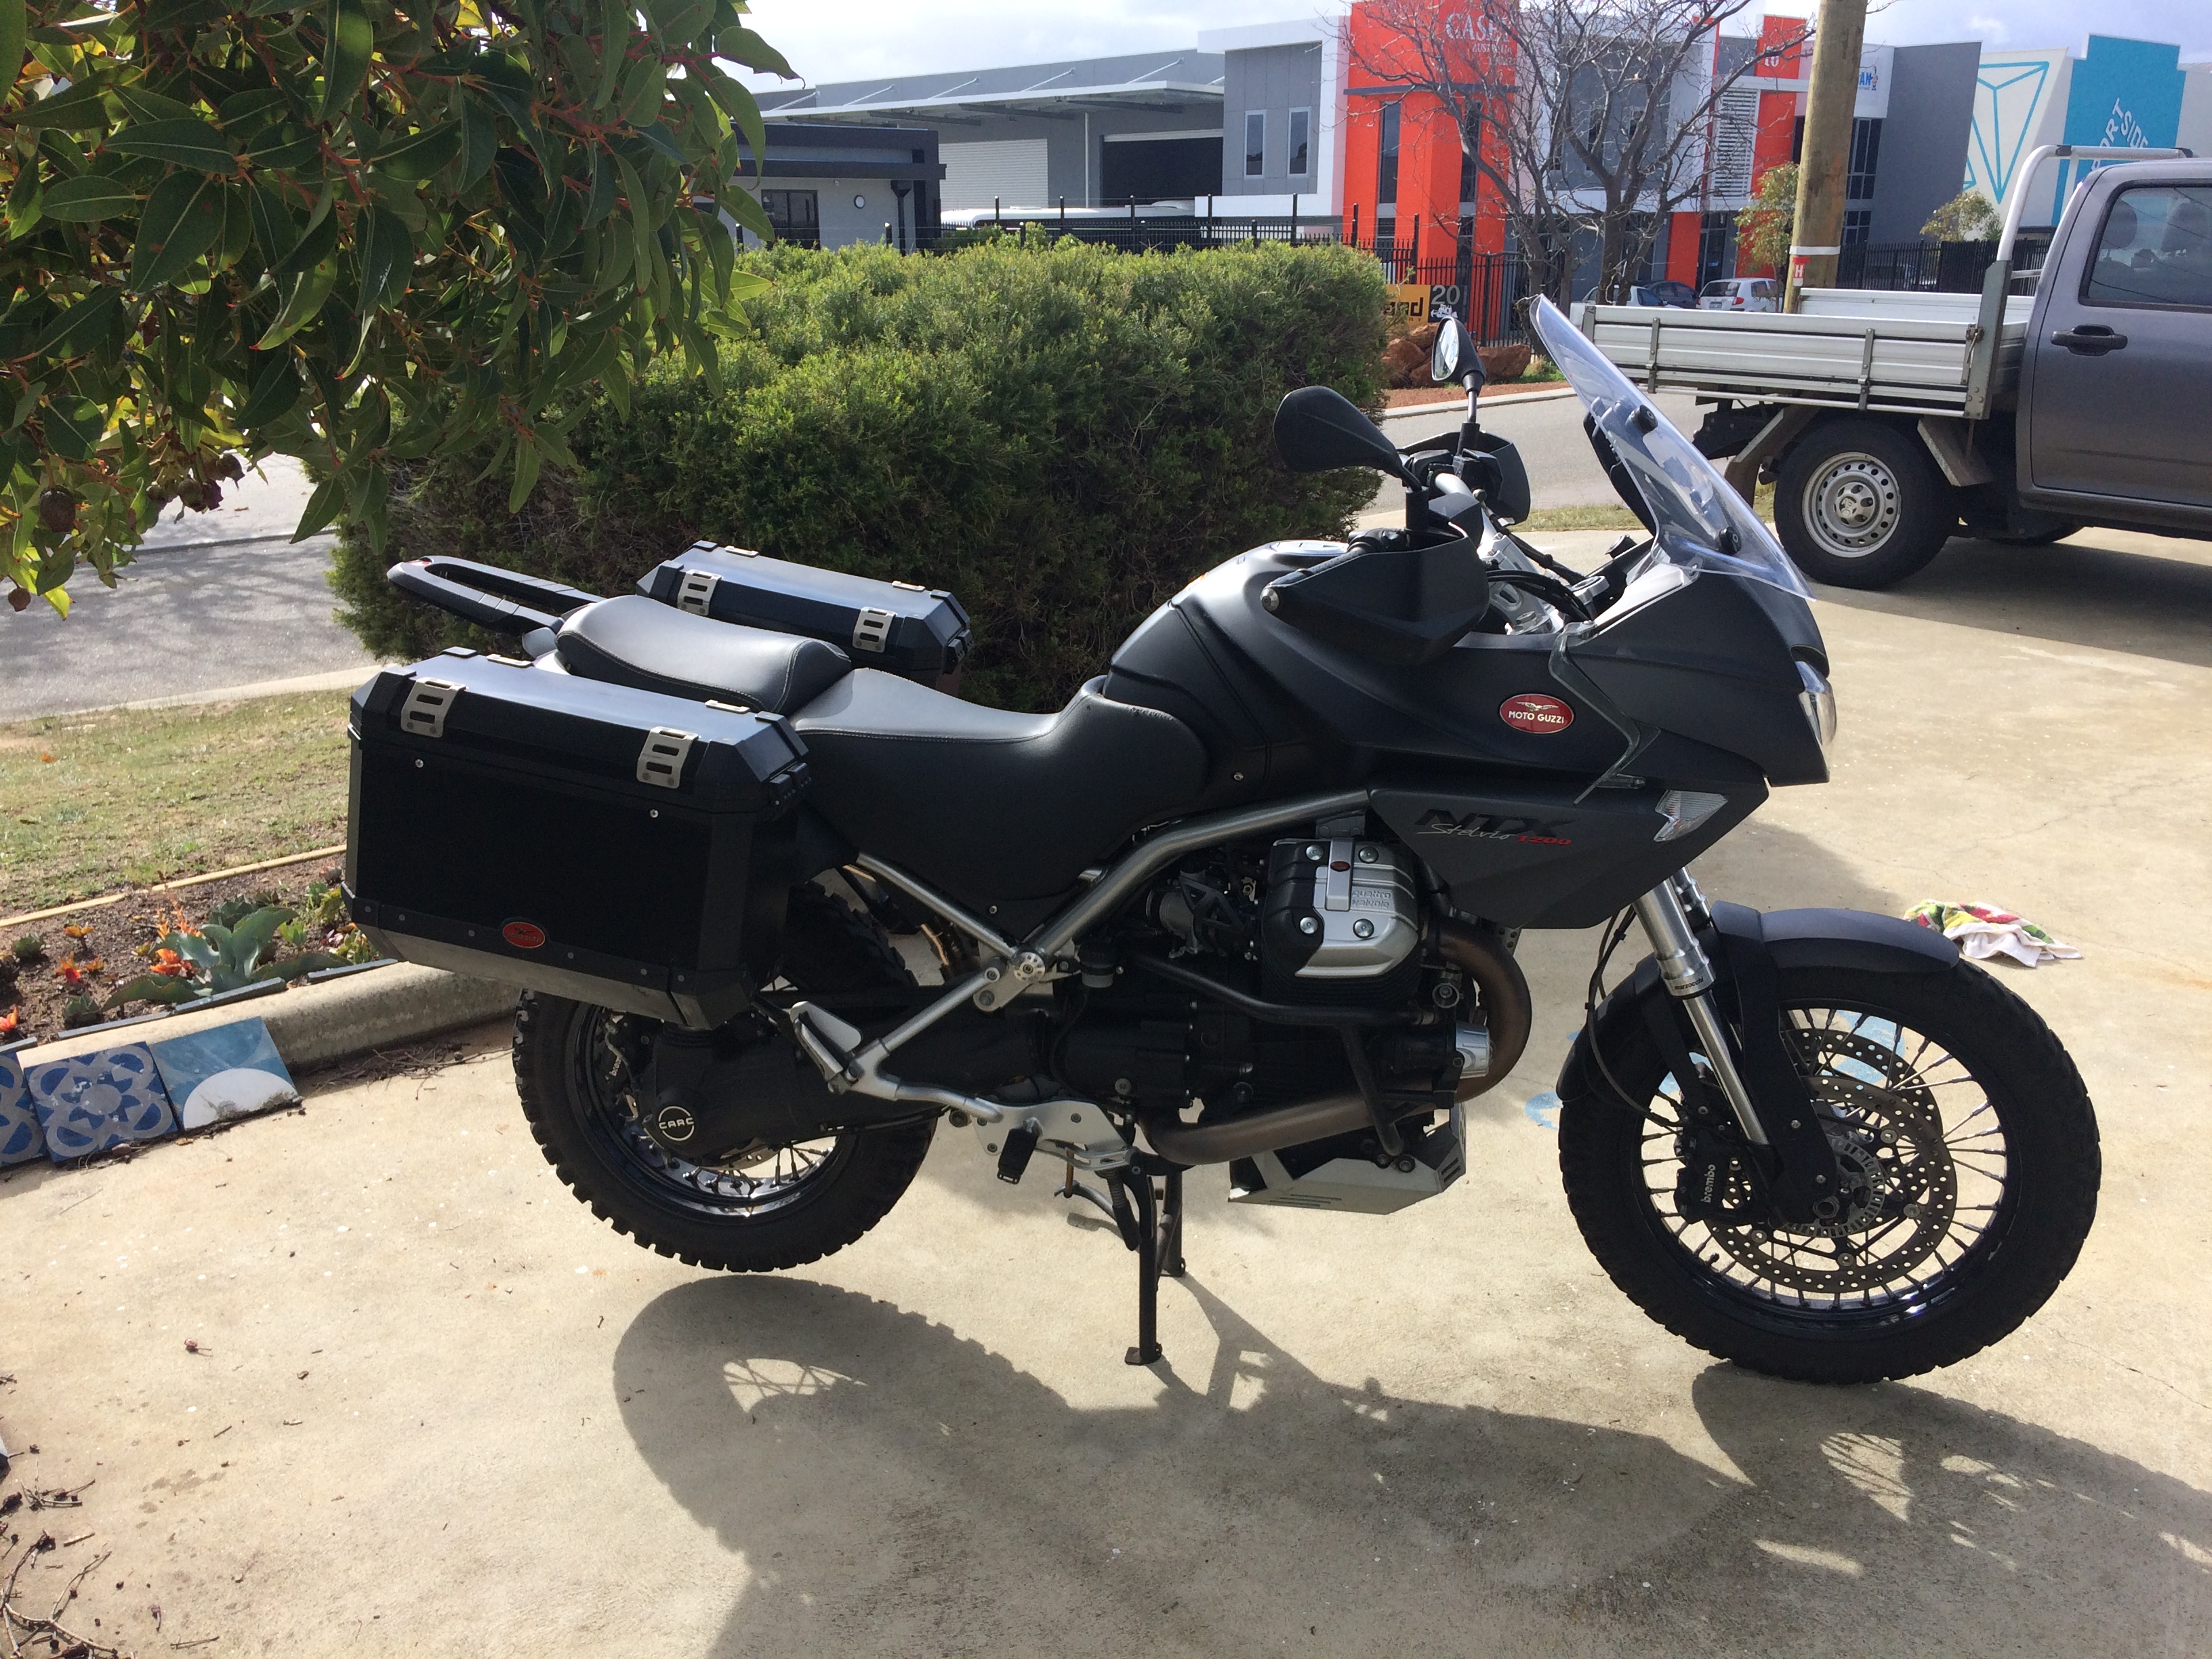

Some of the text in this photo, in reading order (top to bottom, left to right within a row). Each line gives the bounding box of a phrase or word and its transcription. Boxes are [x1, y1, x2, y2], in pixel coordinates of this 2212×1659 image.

[1795, 264, 1803, 277] H
[1431, 285, 1461, 305] 20
[1508, 710, 1565, 724] MOTO GUZZI
[1414, 808, 1577, 838] NTX
[1416, 823, 1572, 846] Stelvio 1200
[1351, 890, 1391, 899] quattro
[1674, 976, 1704, 989] marzocchi
[659, 1118, 694, 1129] CARC
[1700, 1164, 1716, 1203] brembo
